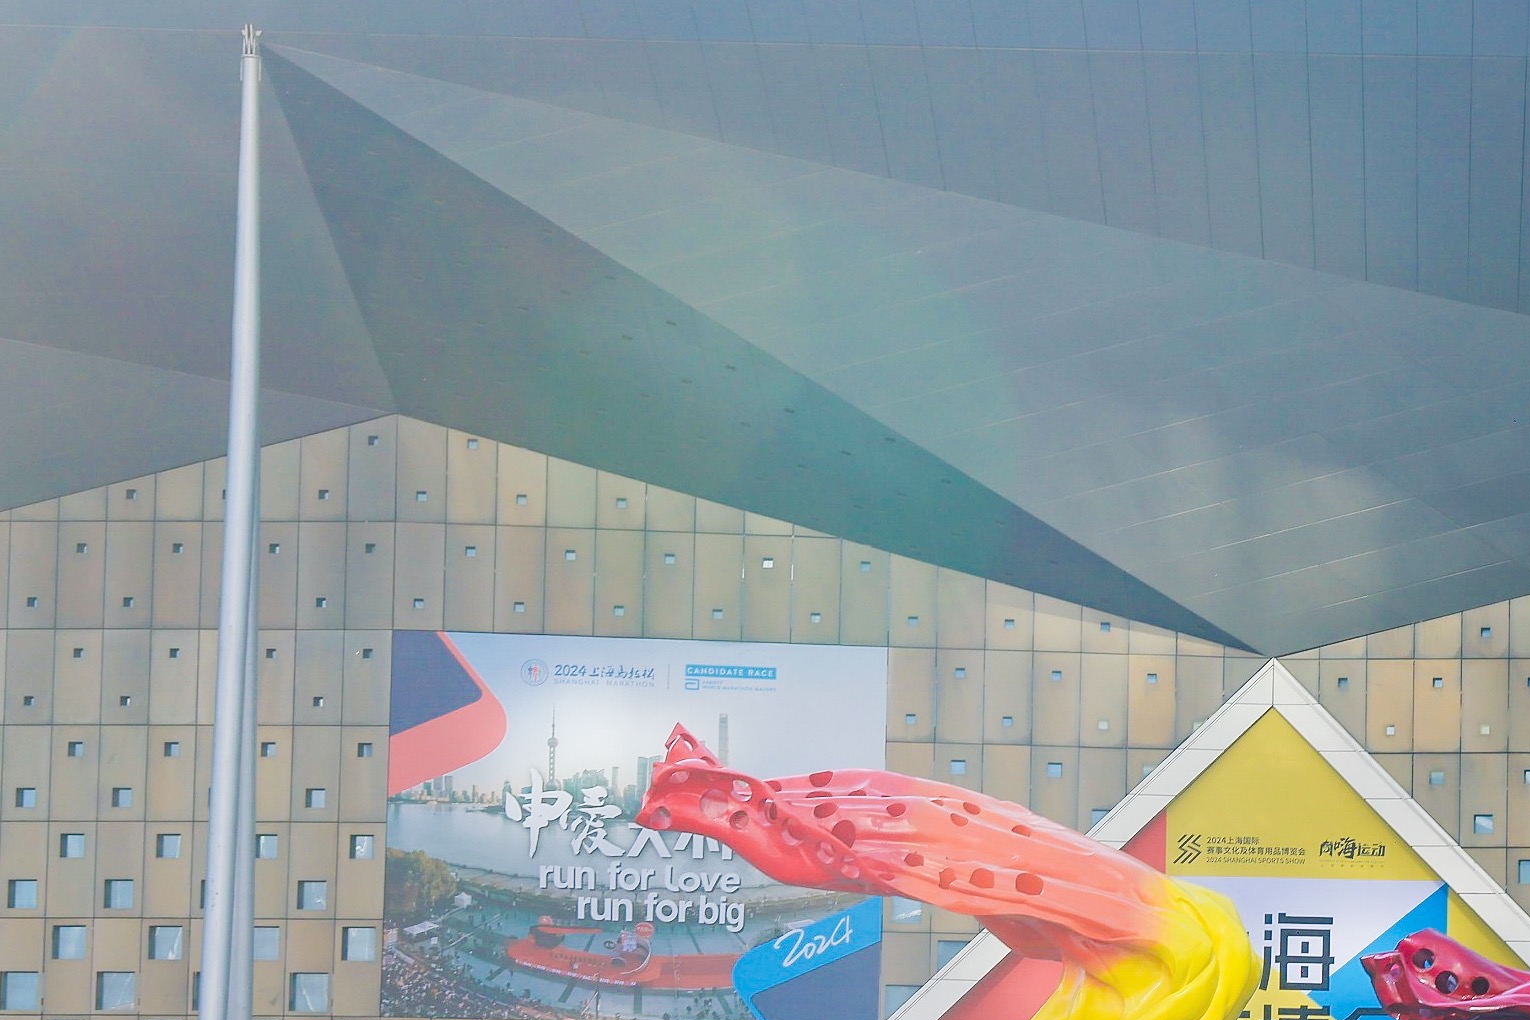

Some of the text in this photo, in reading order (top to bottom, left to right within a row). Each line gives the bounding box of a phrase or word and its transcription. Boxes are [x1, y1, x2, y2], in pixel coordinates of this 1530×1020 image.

[687, 667, 774, 677] CANDIDATE RACE
[1206, 836, 1260, 845] 2024上海国际
[539, 864, 596, 890] run
[608, 861, 655, 891] for
[577, 893, 746, 933] run for big
[774, 916, 854, 969] 2024
